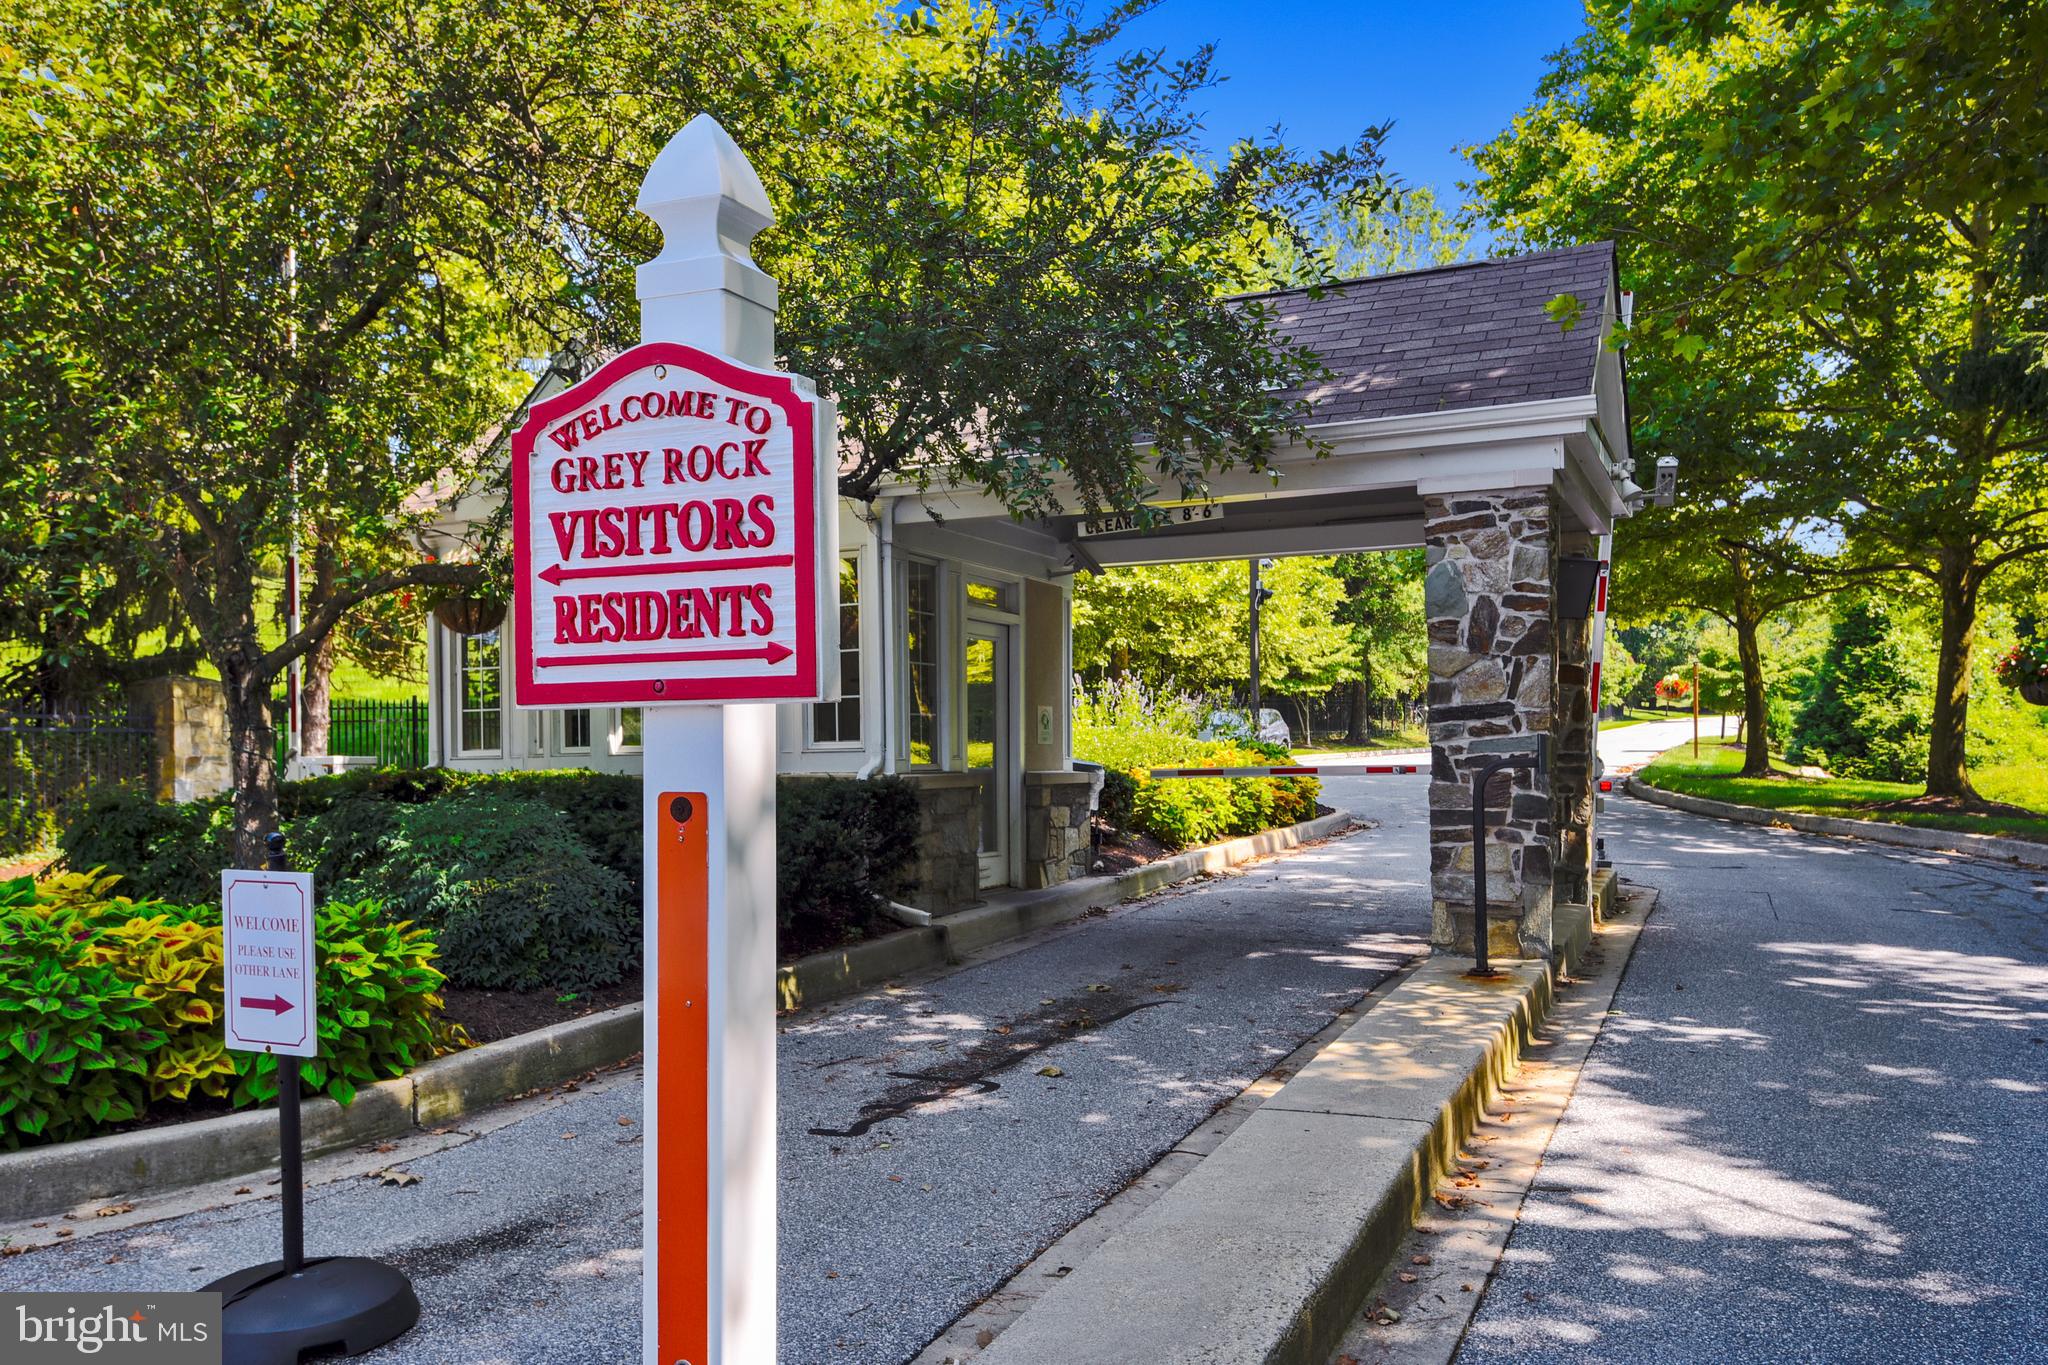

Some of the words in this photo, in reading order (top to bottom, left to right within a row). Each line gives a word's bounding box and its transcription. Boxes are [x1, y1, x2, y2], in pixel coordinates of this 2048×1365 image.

[547, 389, 717, 453] WELCOME
[725, 396, 773, 435] TO
[551, 450, 650, 494] GREY
[662, 438, 772, 486] ROCK
[548, 494, 776, 562] VISITORS
[553, 582, 774, 644] RESIDENTS
[234, 915, 300, 933] WELCOME
[237, 944, 275, 958] PLEASE
[278, 947, 297, 960] USE
[235, 964, 270, 978] OTHER
[272, 966, 300, 980] LANE
